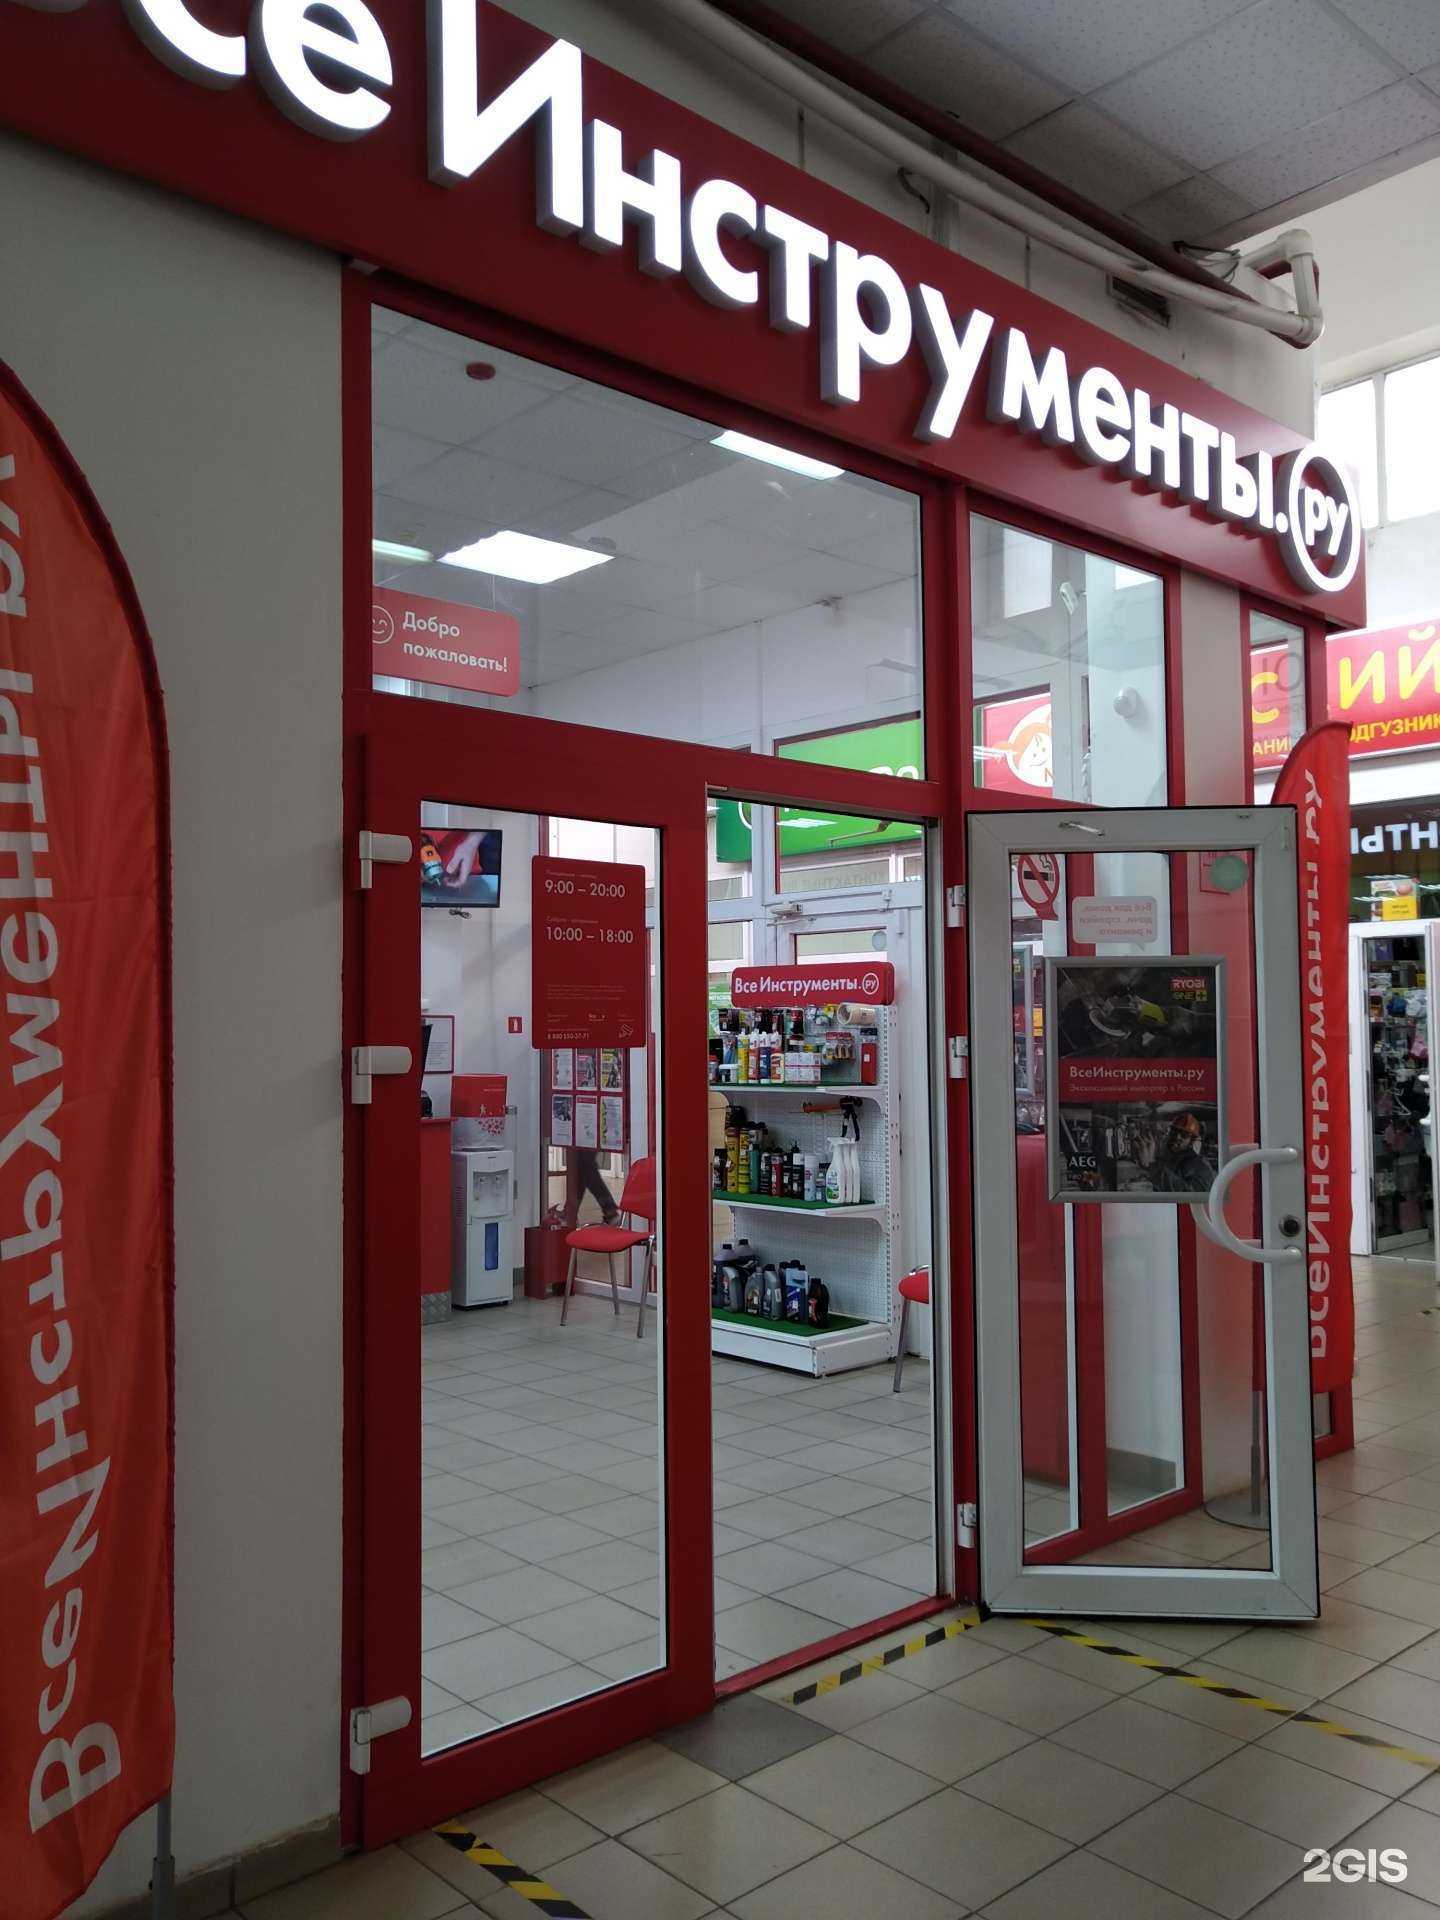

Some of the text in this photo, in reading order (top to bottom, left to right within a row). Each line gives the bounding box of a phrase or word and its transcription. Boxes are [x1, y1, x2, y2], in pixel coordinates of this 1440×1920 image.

[403, 611, 461, 639] Добро
[403, 642, 508, 673] пожаловать!
[545, 879, 574, 894] 9:00
[590, 883, 625, 898] 20:00
[546, 926, 583, 941] 10:00
[599, 928, 634, 943] 18:00
[1070, 1065, 1204, 1080] ВсеИнструменты.ру
[1069, 1156, 1096, 1167] AEG
